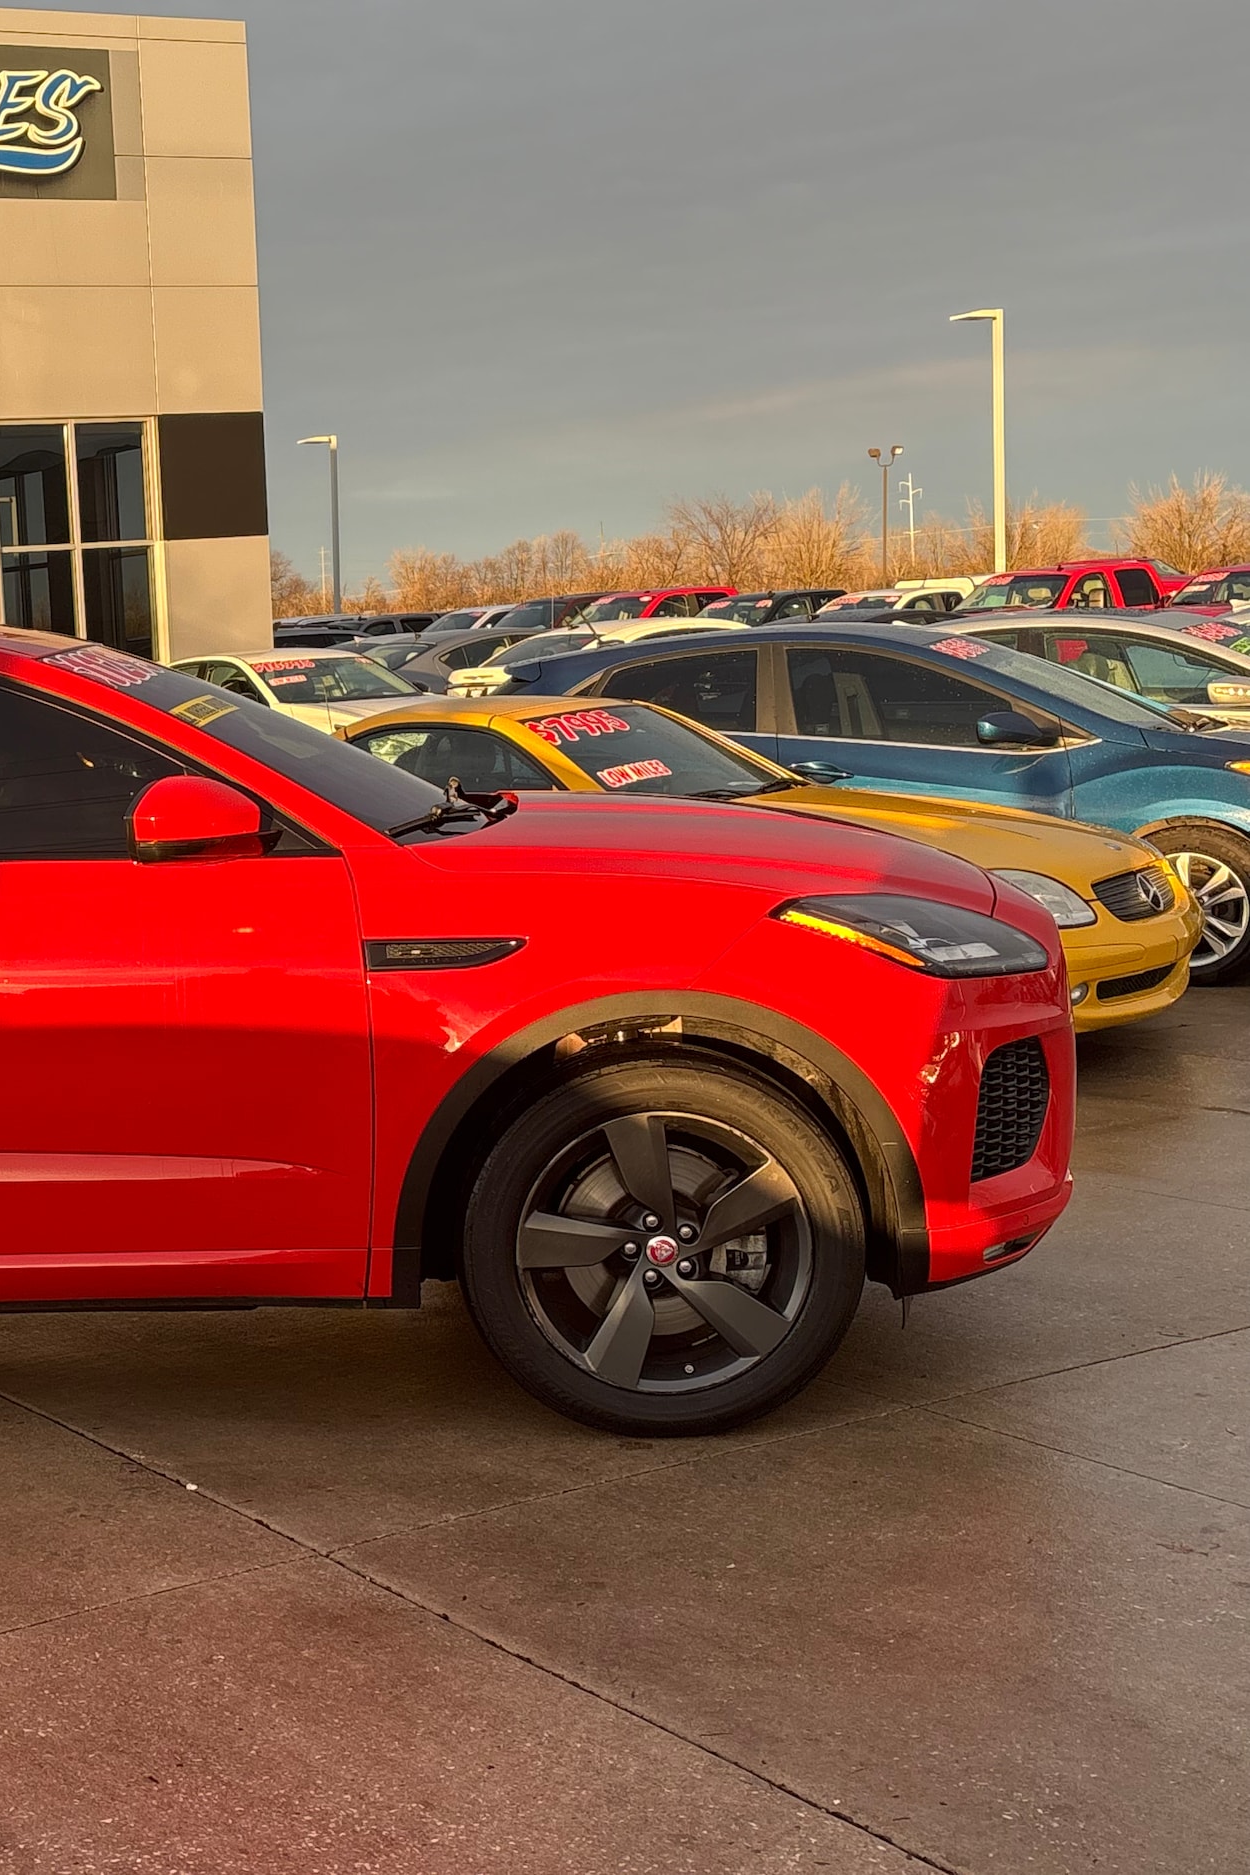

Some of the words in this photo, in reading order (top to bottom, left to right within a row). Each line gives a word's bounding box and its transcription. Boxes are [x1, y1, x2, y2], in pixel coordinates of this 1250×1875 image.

[525, 710, 631, 746] $7995
[597, 766, 630, 788] LOW
[627, 759, 673, 781] MILES
